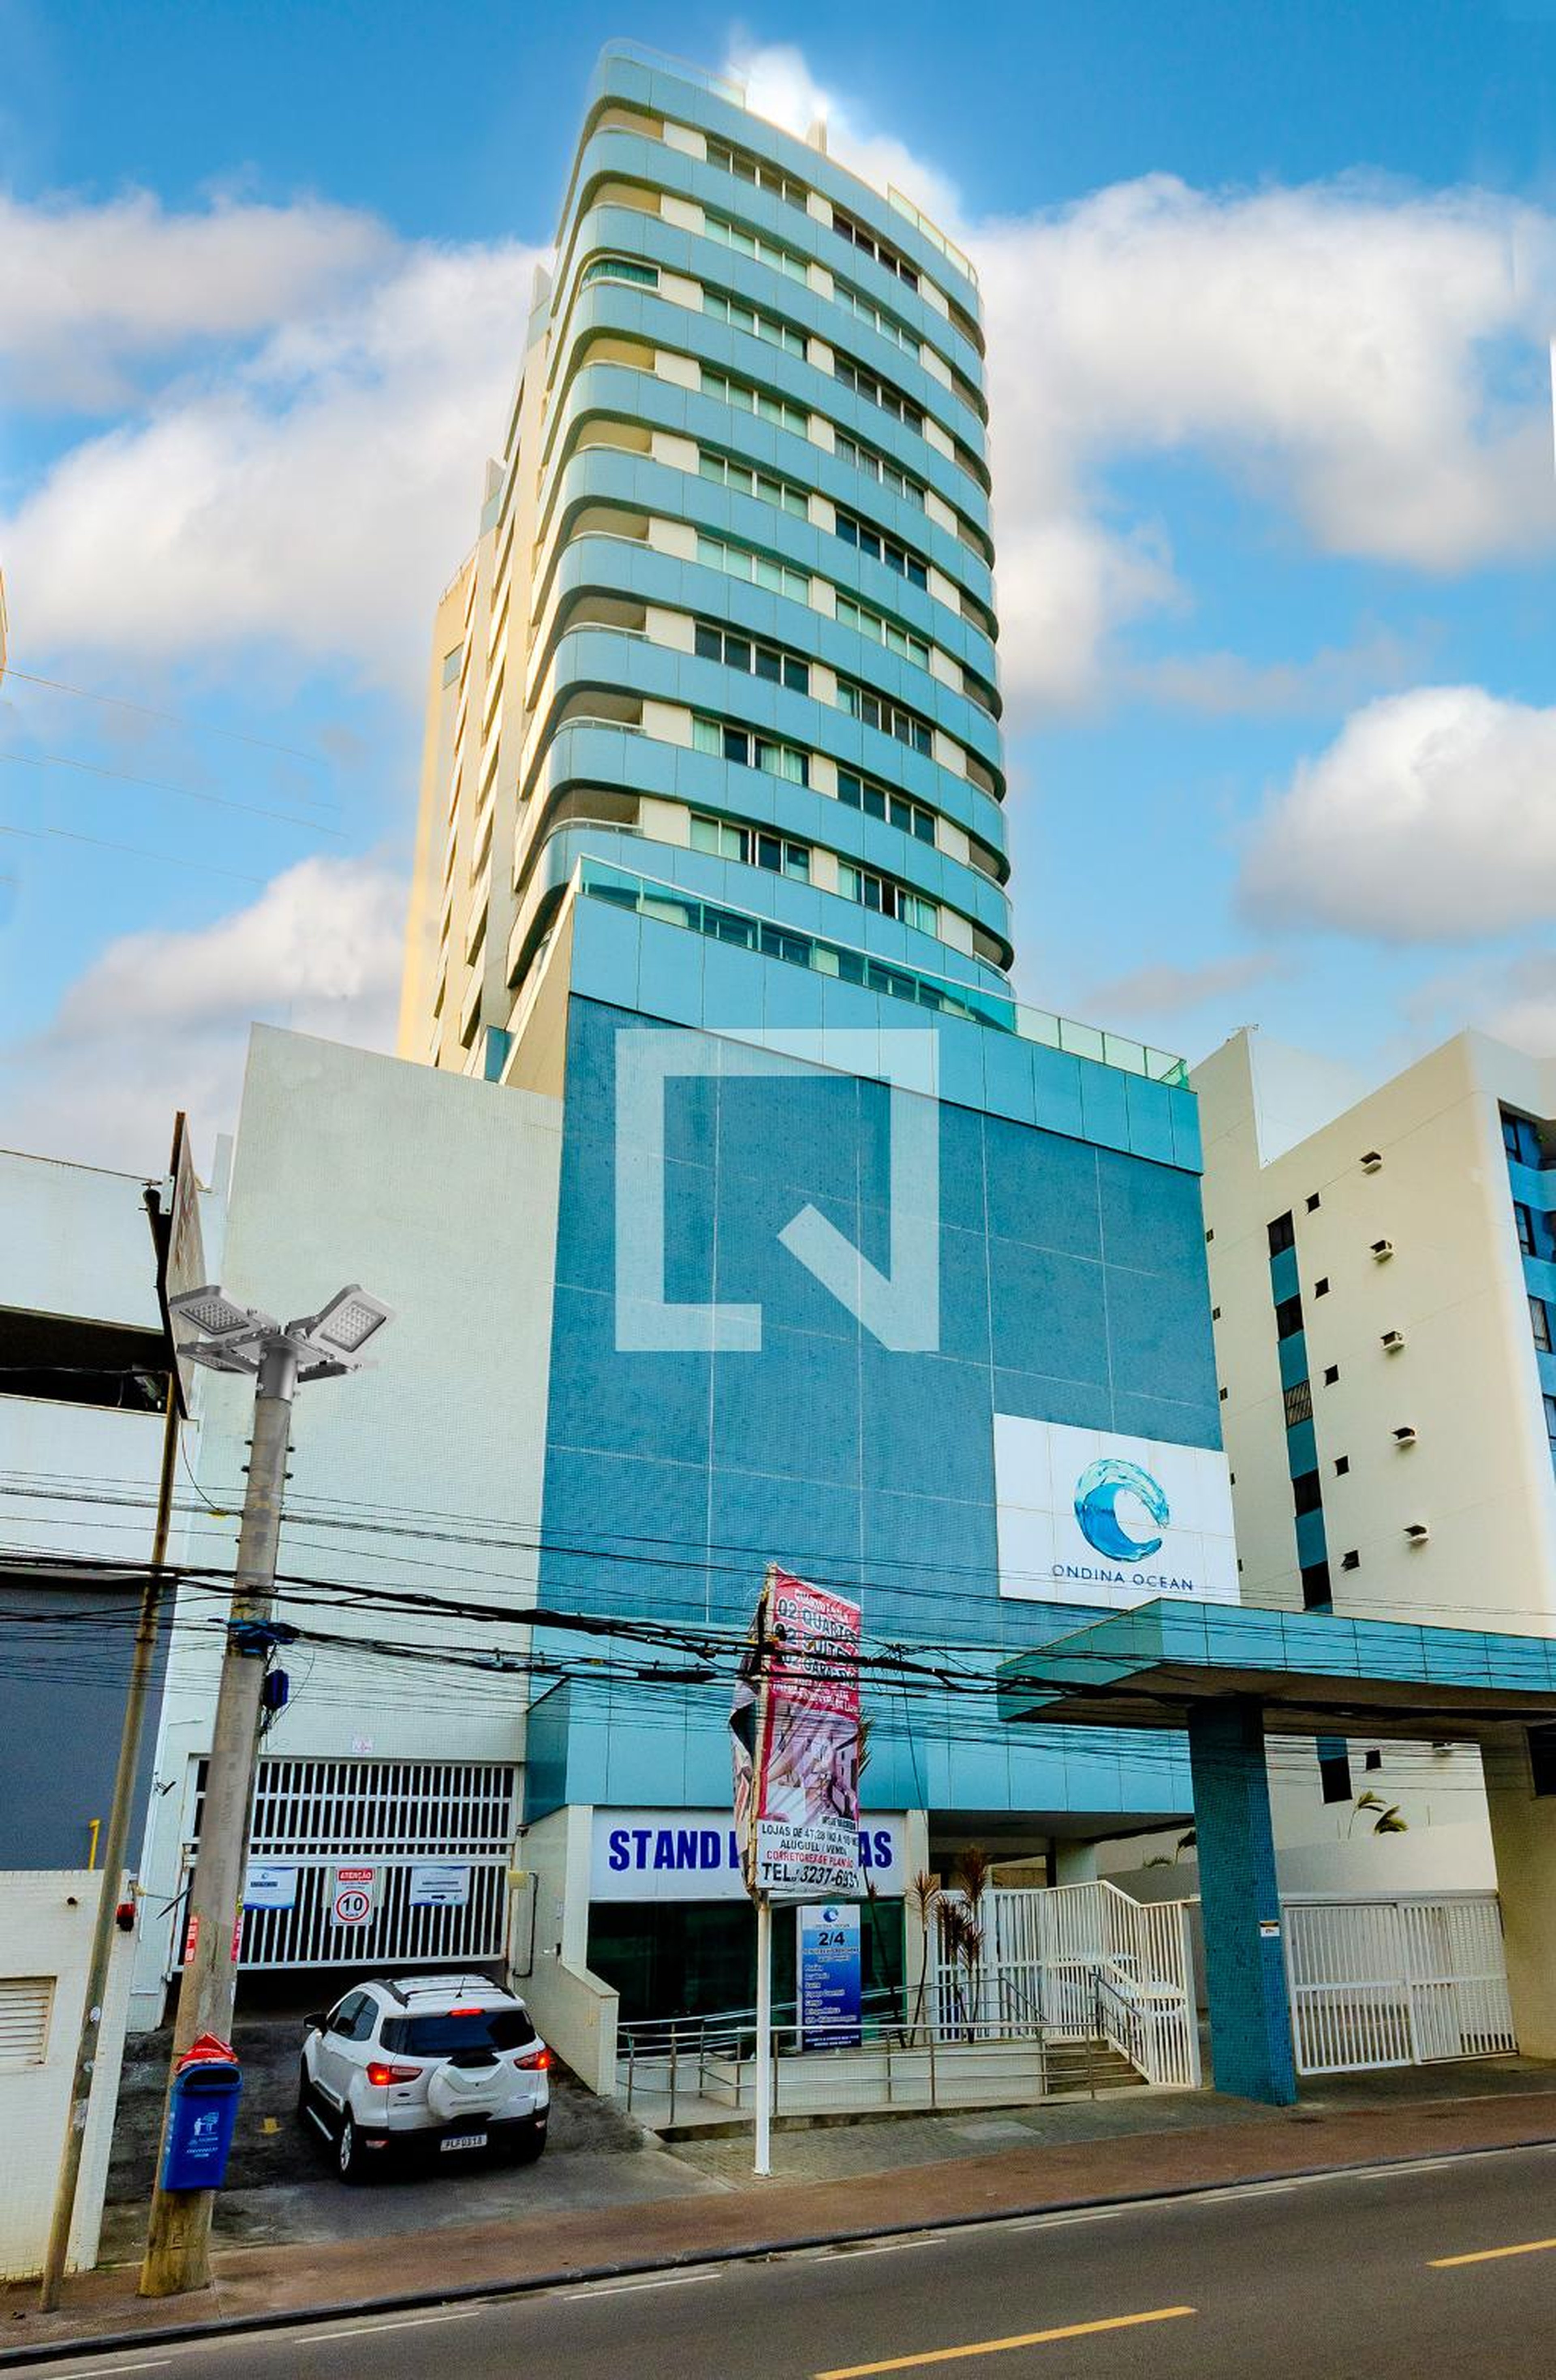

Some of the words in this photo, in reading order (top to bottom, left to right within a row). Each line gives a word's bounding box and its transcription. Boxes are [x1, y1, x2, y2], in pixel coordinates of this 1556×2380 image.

[1052, 1565, 1125, 1583] ONDINA
[1133, 1574, 1193, 1591] OCEAN
[762, 1824, 791, 1837] LOJAS
[793, 1828, 803, 1837] DE
[609, 1830, 721, 1871] STAND
[780, 1840, 819, 1852] ALUGUEL
[343, 1897, 363, 1911] 10
[819, 1931, 845, 1946] 2/4
